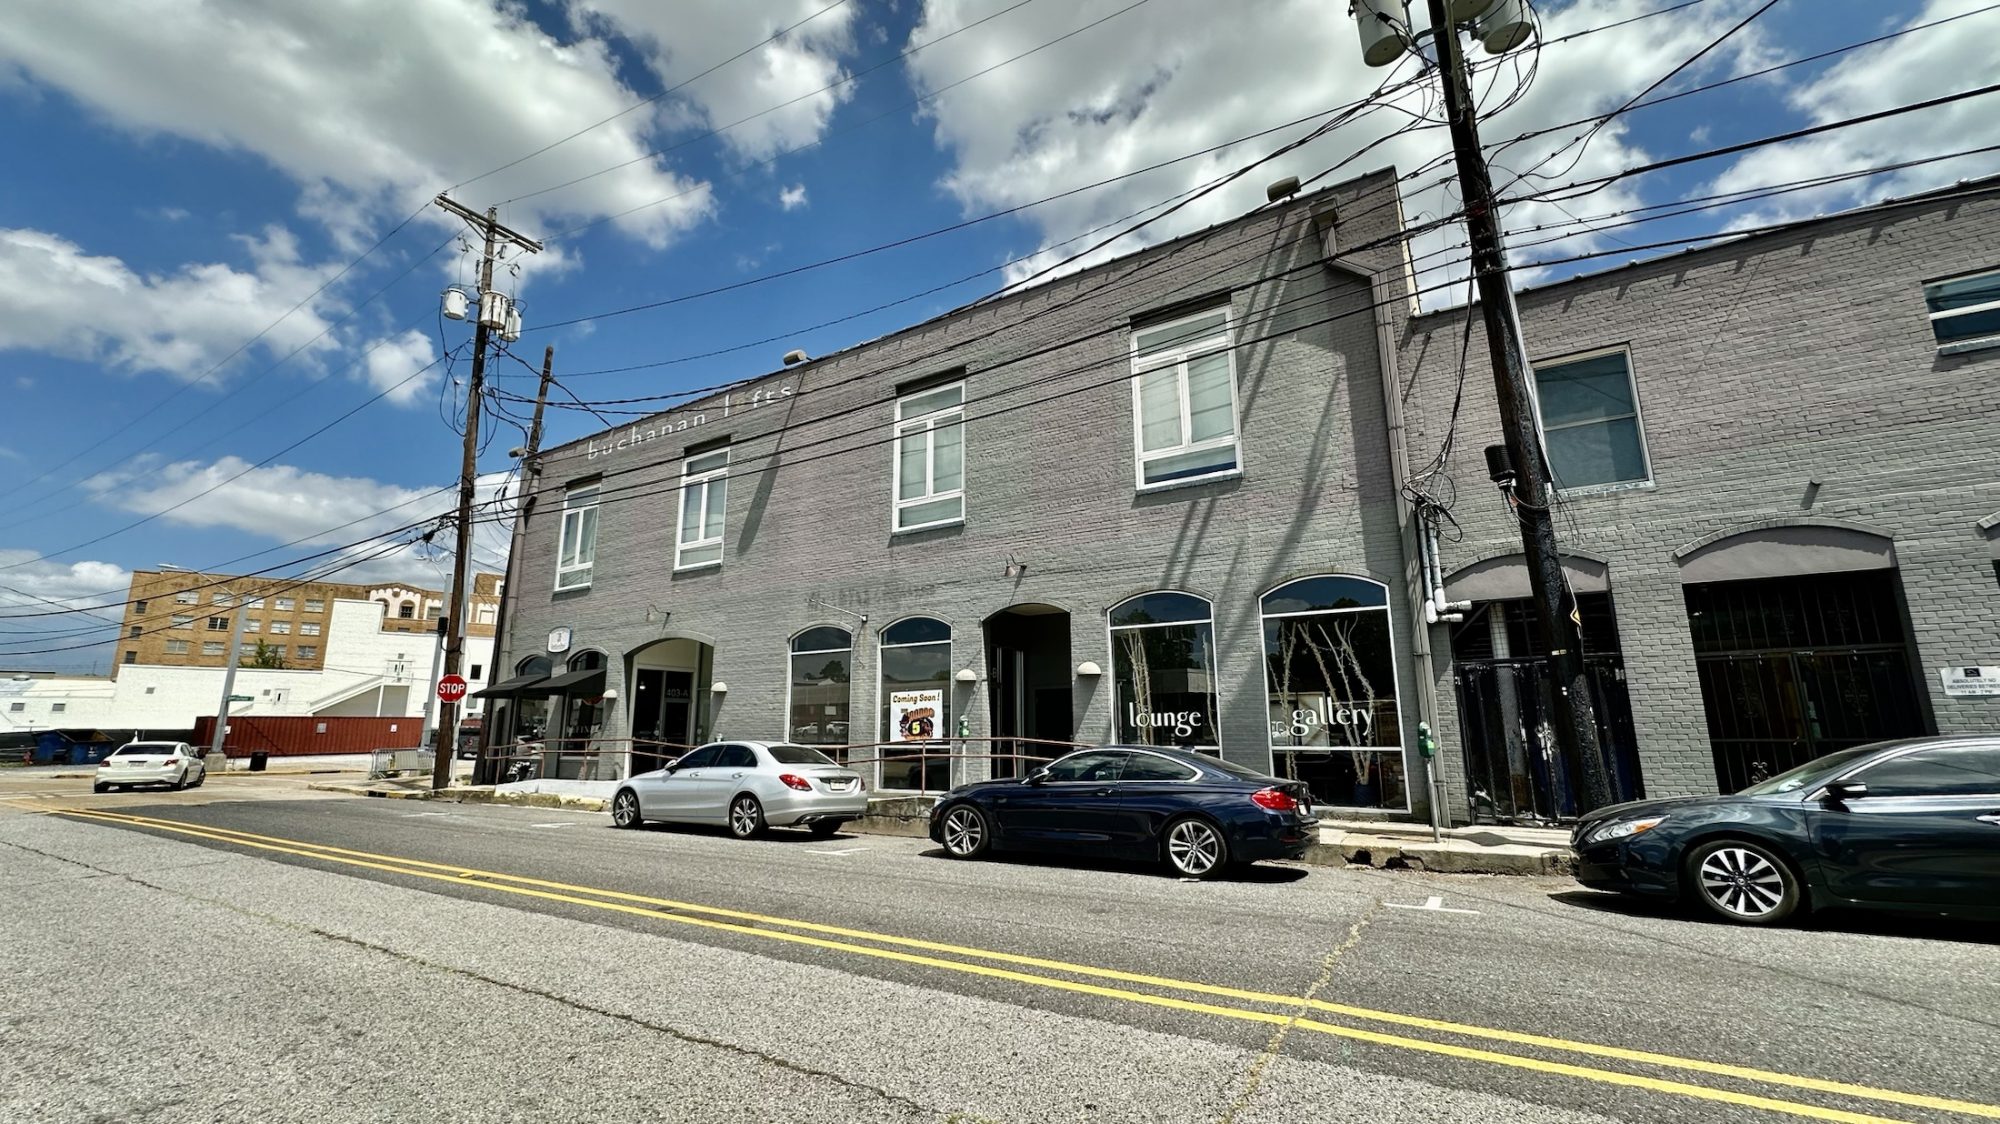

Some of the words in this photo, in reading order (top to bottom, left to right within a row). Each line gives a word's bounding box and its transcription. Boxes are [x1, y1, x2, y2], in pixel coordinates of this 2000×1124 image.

[587, 412, 706, 461] buchanan
[723, 385, 792, 417] lfts
[439, 682, 465, 694] STOP
[666, 687, 689, 698] 403-A
[893, 694, 918, 705] Coming
[1129, 701, 1202, 737] lounge
[1290, 696, 1374, 736] gallery
